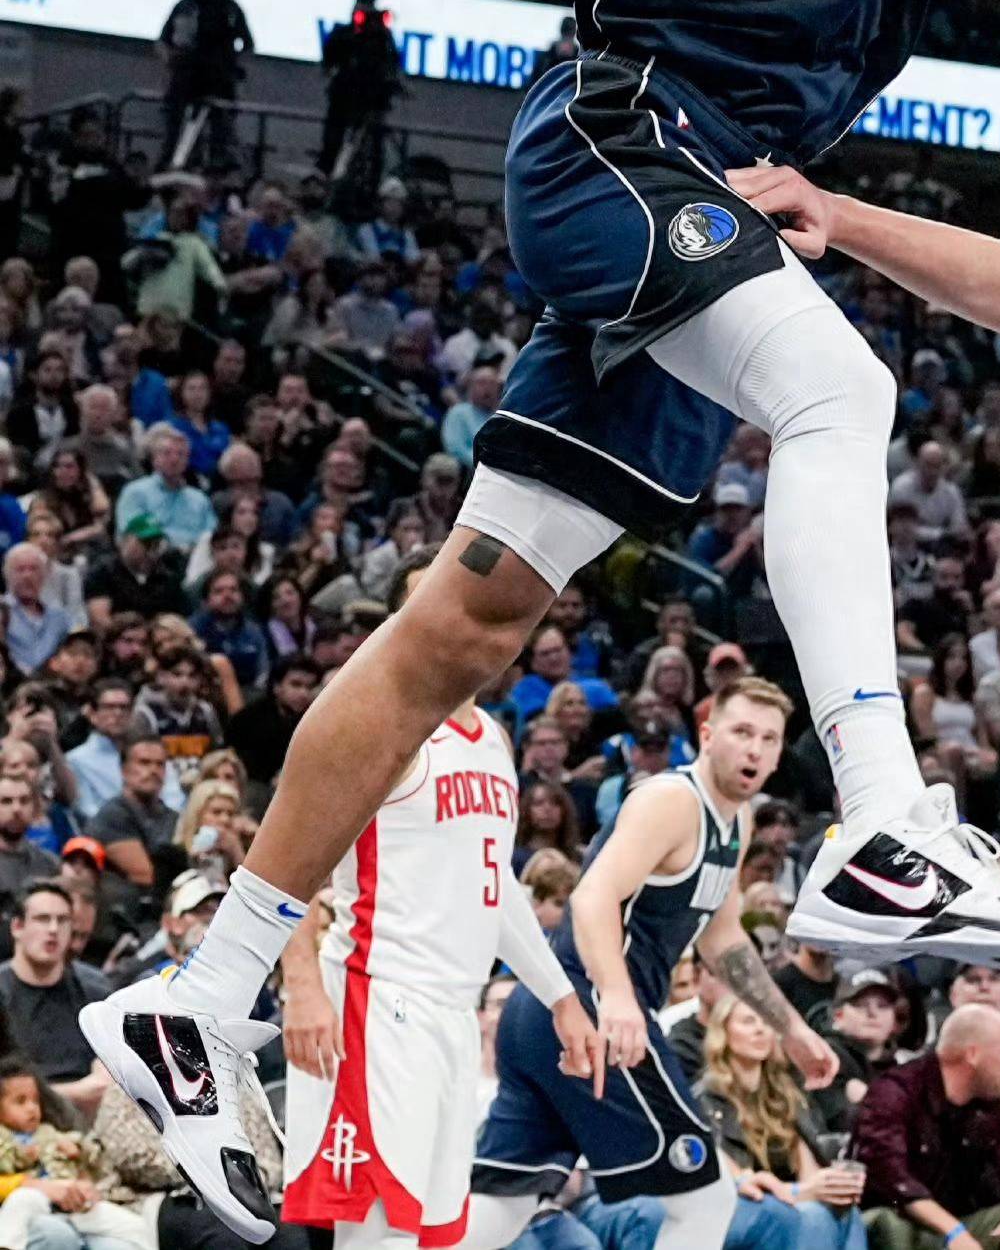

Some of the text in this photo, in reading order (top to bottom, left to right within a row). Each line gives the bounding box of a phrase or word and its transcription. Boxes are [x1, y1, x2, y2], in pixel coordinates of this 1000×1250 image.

[446, 36, 546, 91] MOR
[434, 770, 519, 824] ROCKET
[483, 836, 499, 907] 5
